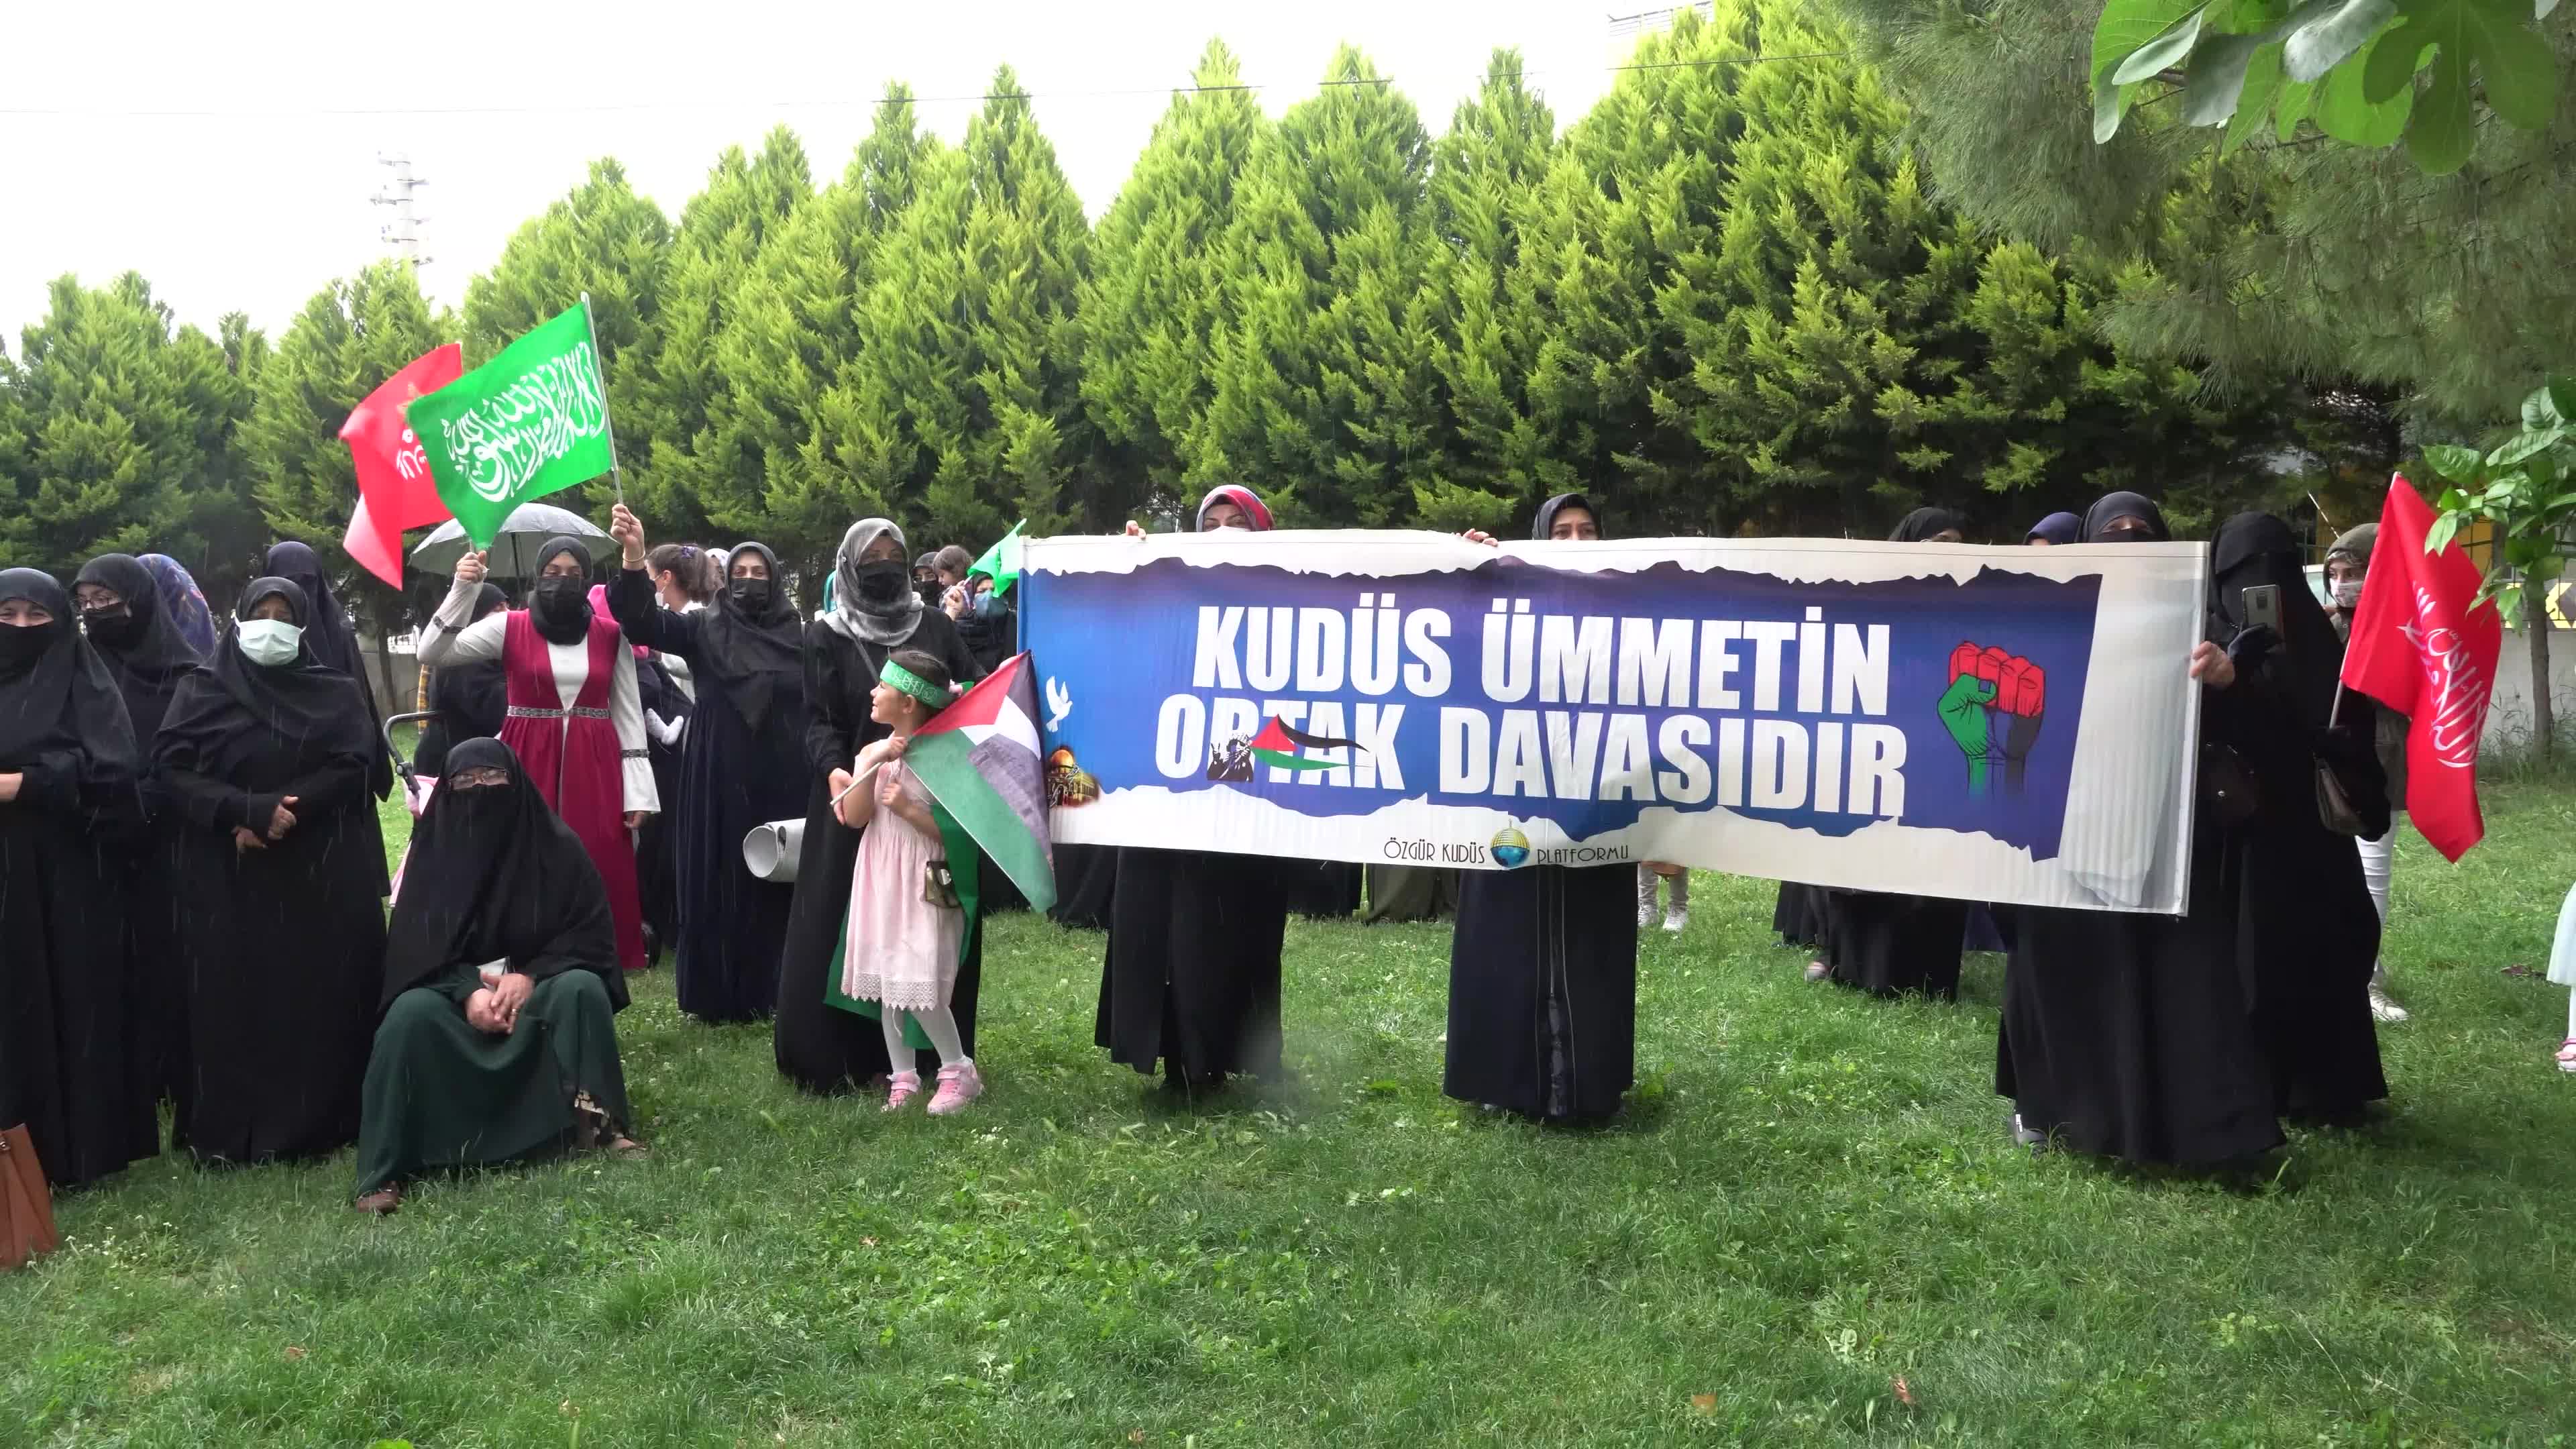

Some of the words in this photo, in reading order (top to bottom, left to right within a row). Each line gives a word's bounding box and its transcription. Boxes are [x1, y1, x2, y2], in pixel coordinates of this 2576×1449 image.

[1193, 592, 1452, 697] KUDÜS
[1482, 598, 1890, 715] ÜMMETİN
[1440, 706, 1907, 816] DAVASIDIR
[1384, 837, 1435, 861] ÖZGÜR
[1442, 841, 1485, 863] KUDÜS
[1537, 845, 1629, 865] PLATFORMU
